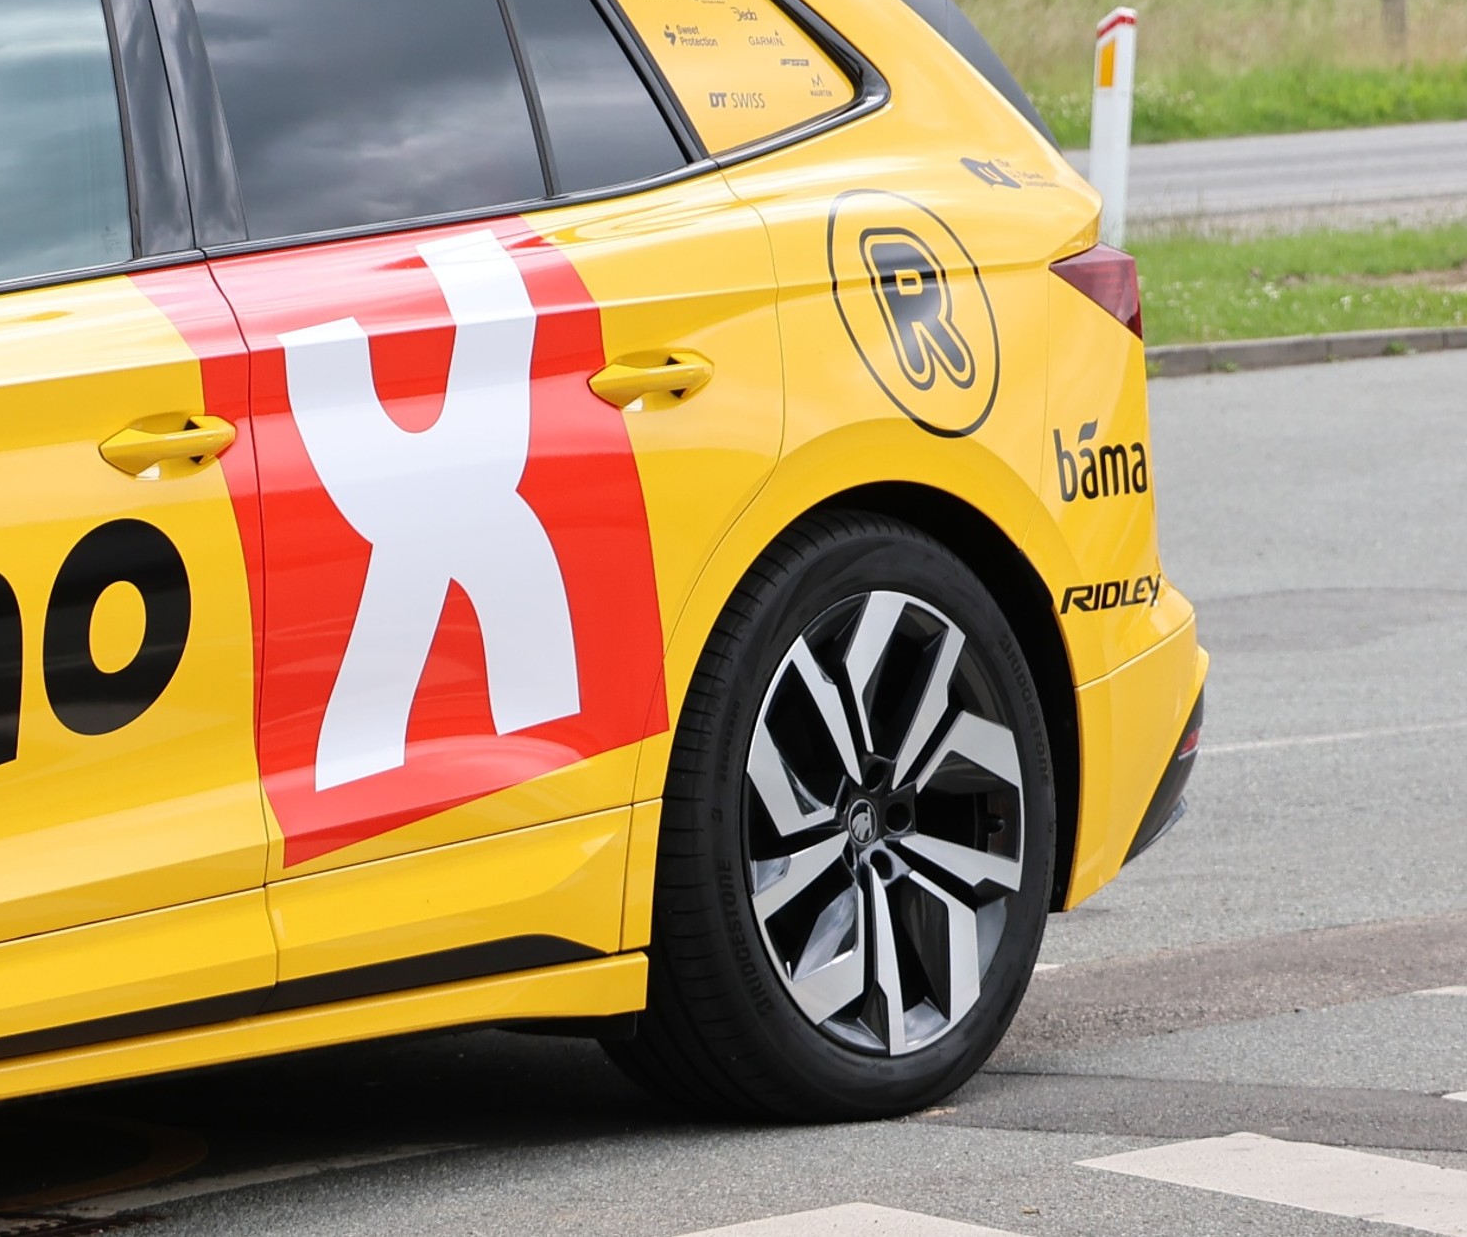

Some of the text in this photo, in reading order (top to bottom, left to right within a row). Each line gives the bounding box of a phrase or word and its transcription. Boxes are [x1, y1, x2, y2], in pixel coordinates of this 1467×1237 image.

[675, 24, 700, 35] Sweet
[679, 35, 719, 47] Protection
[748, 35, 785, 47] GARMIN
[708, 92, 766, 109] DT SWISS
[276, 228, 581, 792] X
[1059, 572, 1162, 616] RIDLEY
